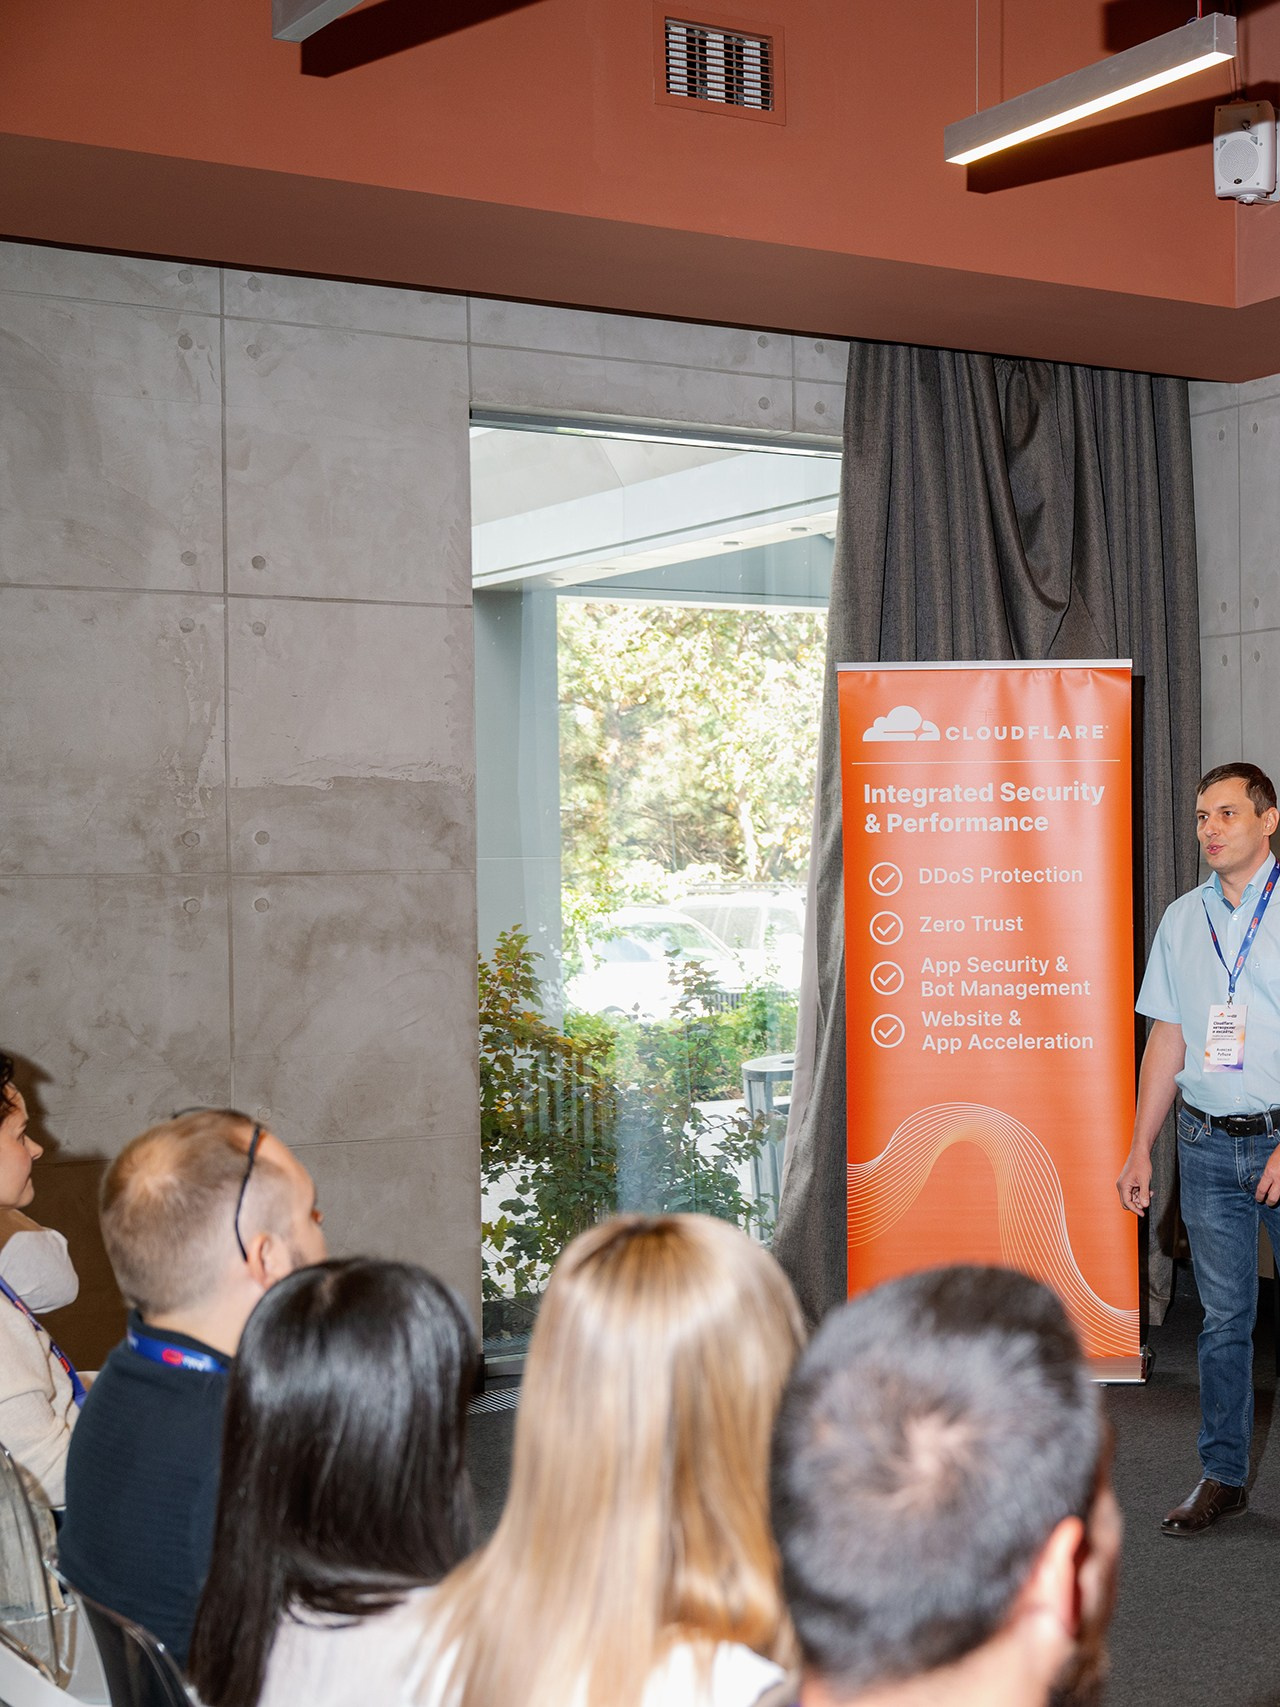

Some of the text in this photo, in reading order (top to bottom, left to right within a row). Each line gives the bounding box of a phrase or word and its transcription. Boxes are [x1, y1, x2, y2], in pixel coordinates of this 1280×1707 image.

[945, 725, 1104, 741] CLOUDFLARE
[864, 781, 1105, 809] Integrated Security
[864, 812, 1049, 833] & Performance
[919, 866, 1083, 884] DDoS Protection
[919, 915, 1024, 933] Zero Trust
[921, 955, 1069, 977] App Security &
[921, 980, 1091, 1000] Bot Management
[921, 1009, 1022, 1027] Website &
[922, 1033, 1094, 1055] App Acceleration
